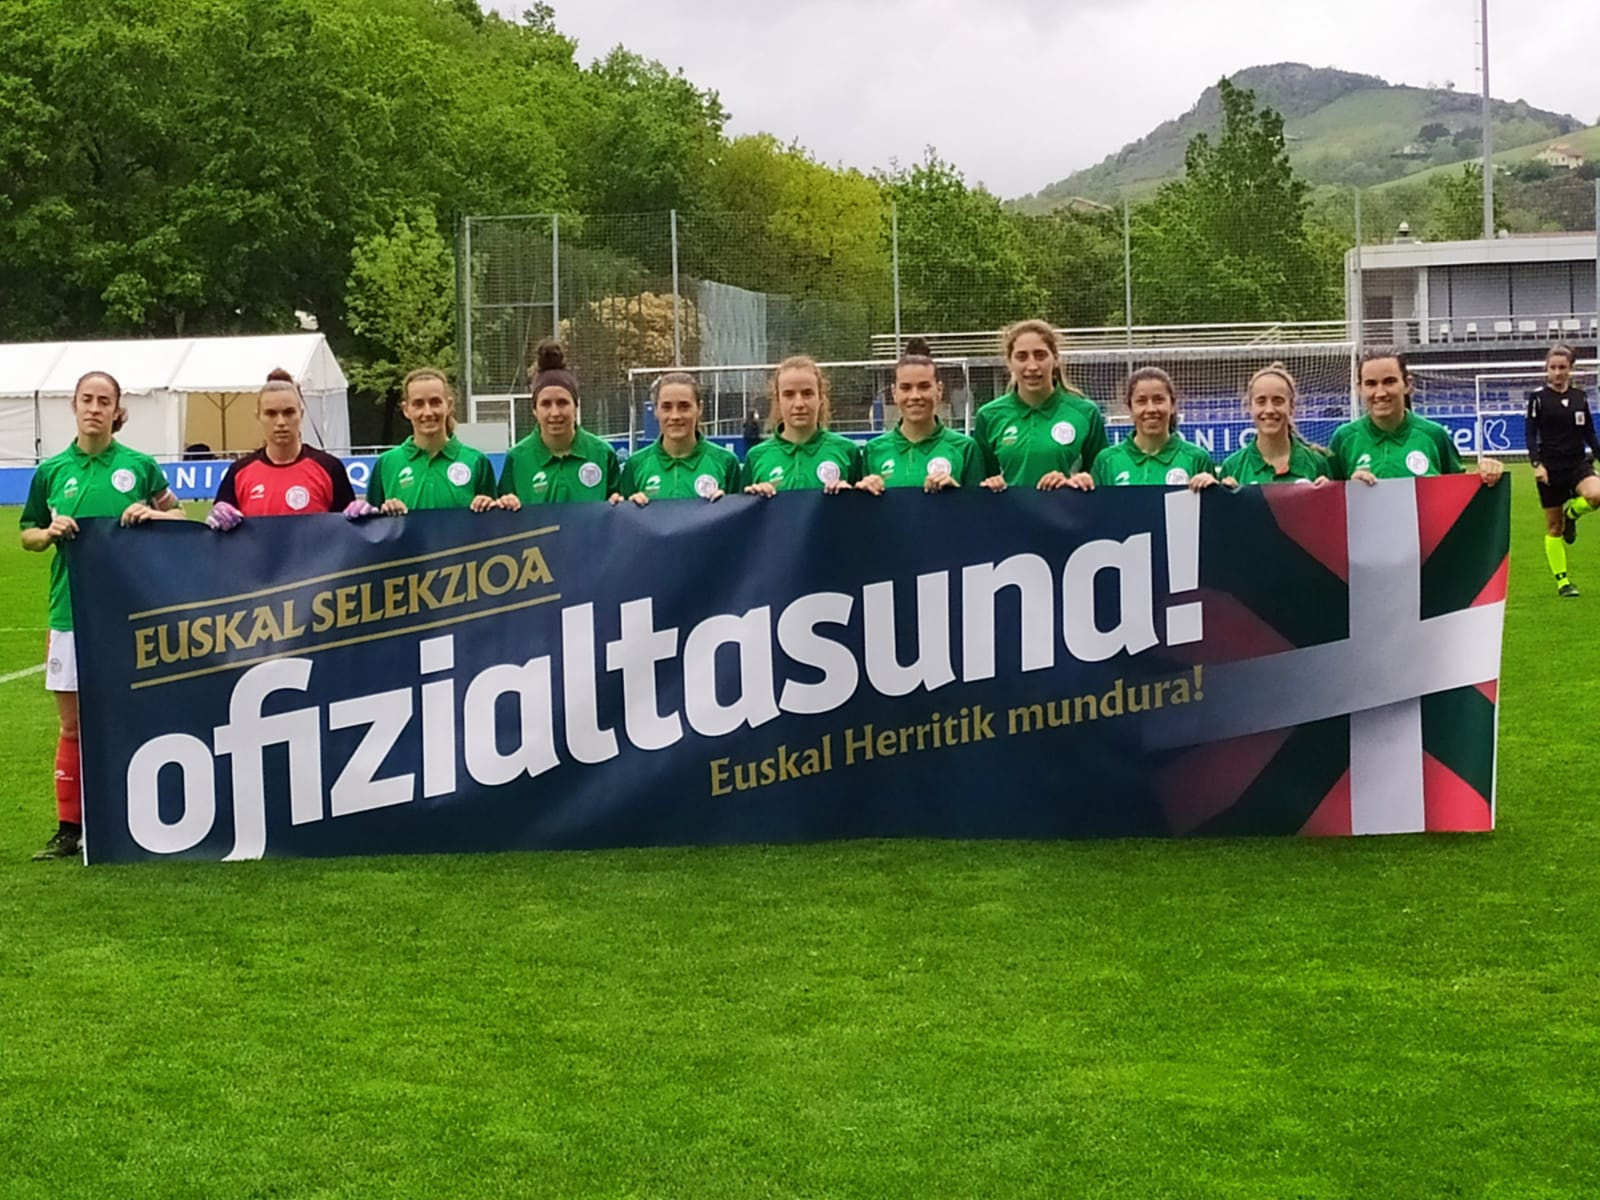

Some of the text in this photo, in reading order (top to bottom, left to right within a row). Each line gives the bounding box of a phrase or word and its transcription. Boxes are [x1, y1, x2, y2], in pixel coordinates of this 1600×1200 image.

[134, 546, 554, 670] EUSKAL SELEKZIOA
[126, 489, 1204, 862] ofizialtasuna!
[709, 665, 1205, 797] Euskal Herritik mundura!
